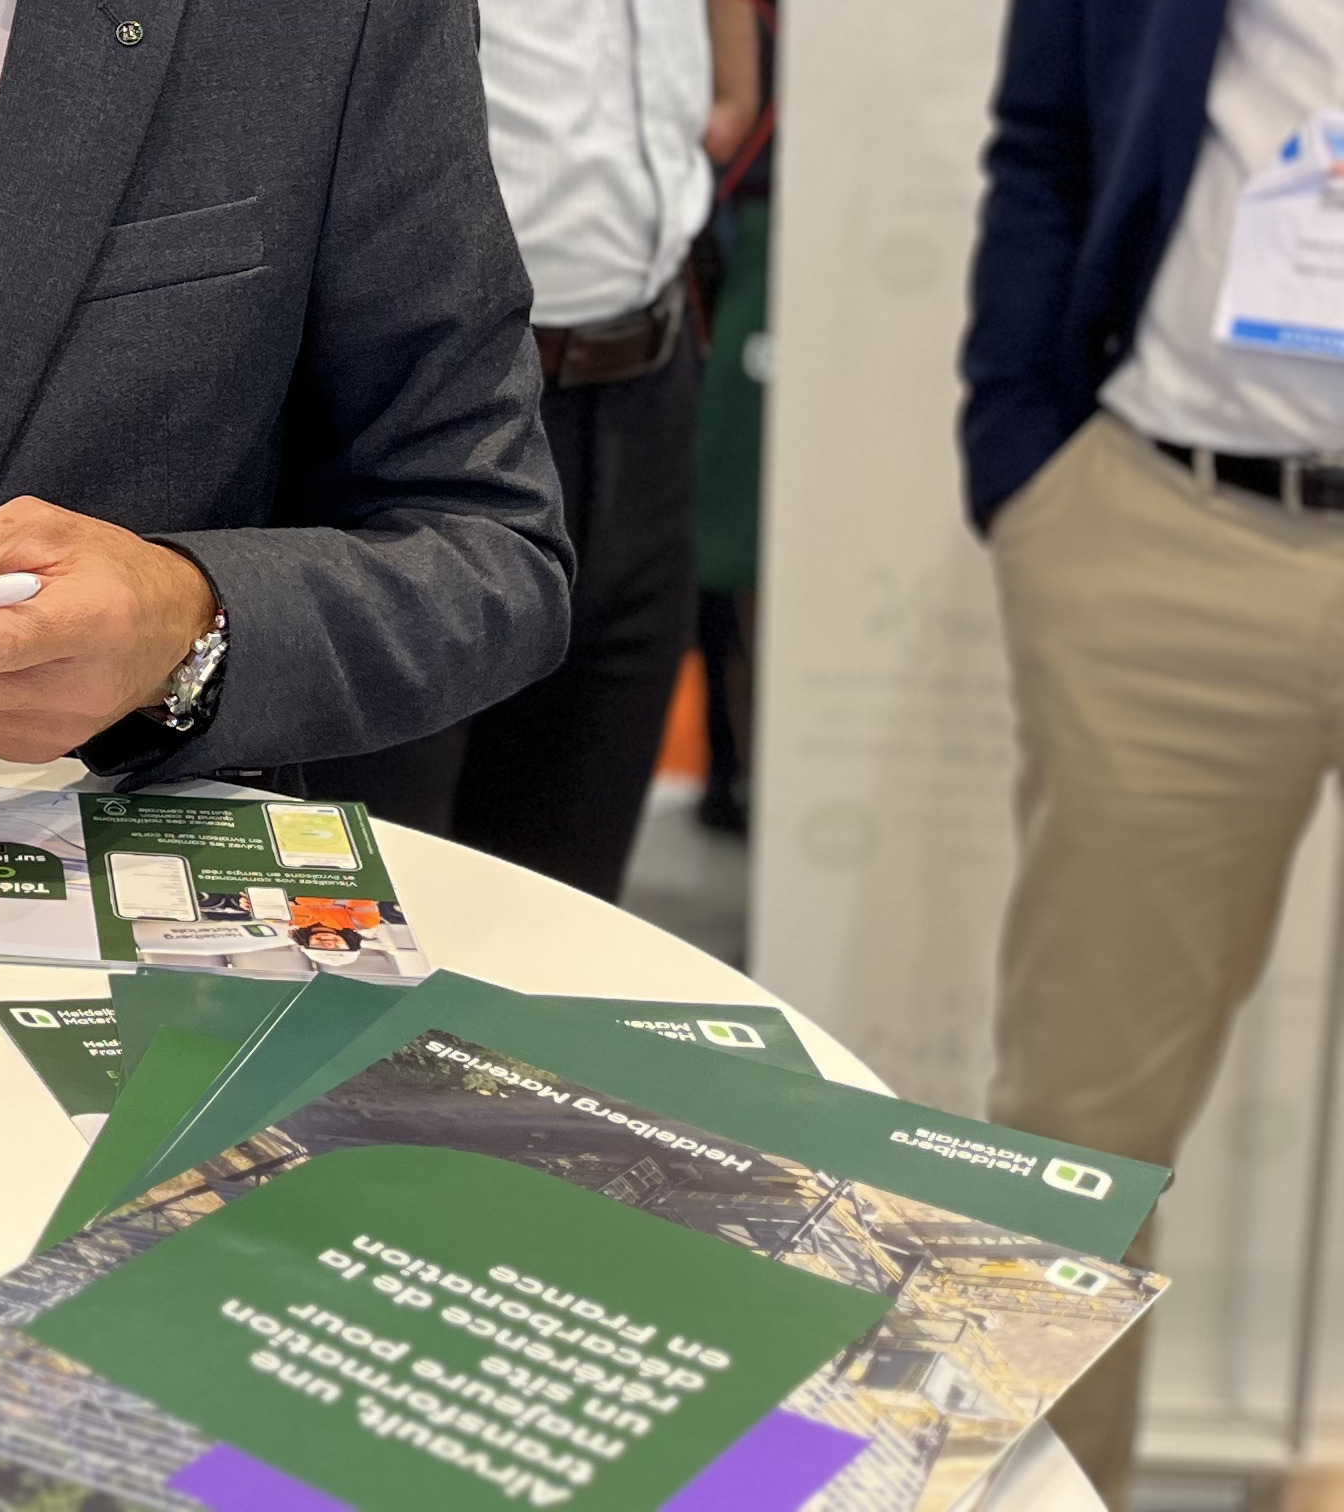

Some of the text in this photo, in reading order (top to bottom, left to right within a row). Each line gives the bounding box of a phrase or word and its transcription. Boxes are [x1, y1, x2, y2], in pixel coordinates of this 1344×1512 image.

[189, 819, 235, 828] Recevez
[228, 843, 264, 851] Suivez
[14, 854, 46, 862] sur
[197, 874, 272, 883] commandes
[164, 931, 242, 940] Heidelberg
[82, 1039, 121, 1048] Heid
[424, 1040, 753, 1172] Heidelberg Materials
[889, 1128, 1032, 1177] Heidelberg
[914, 1127, 1039, 1167] Materials
[317, 1248, 680, 1414] référence de la
[351, 1233, 706, 1391] décarbonation
[487, 1264, 731, 1370] en France
[220, 1298, 596, 1485] transformation
[286, 1301, 626, 1460] majeure pour
[478, 1354, 652, 1436] un site
[248, 1348, 574, 1509] Airvault, une
